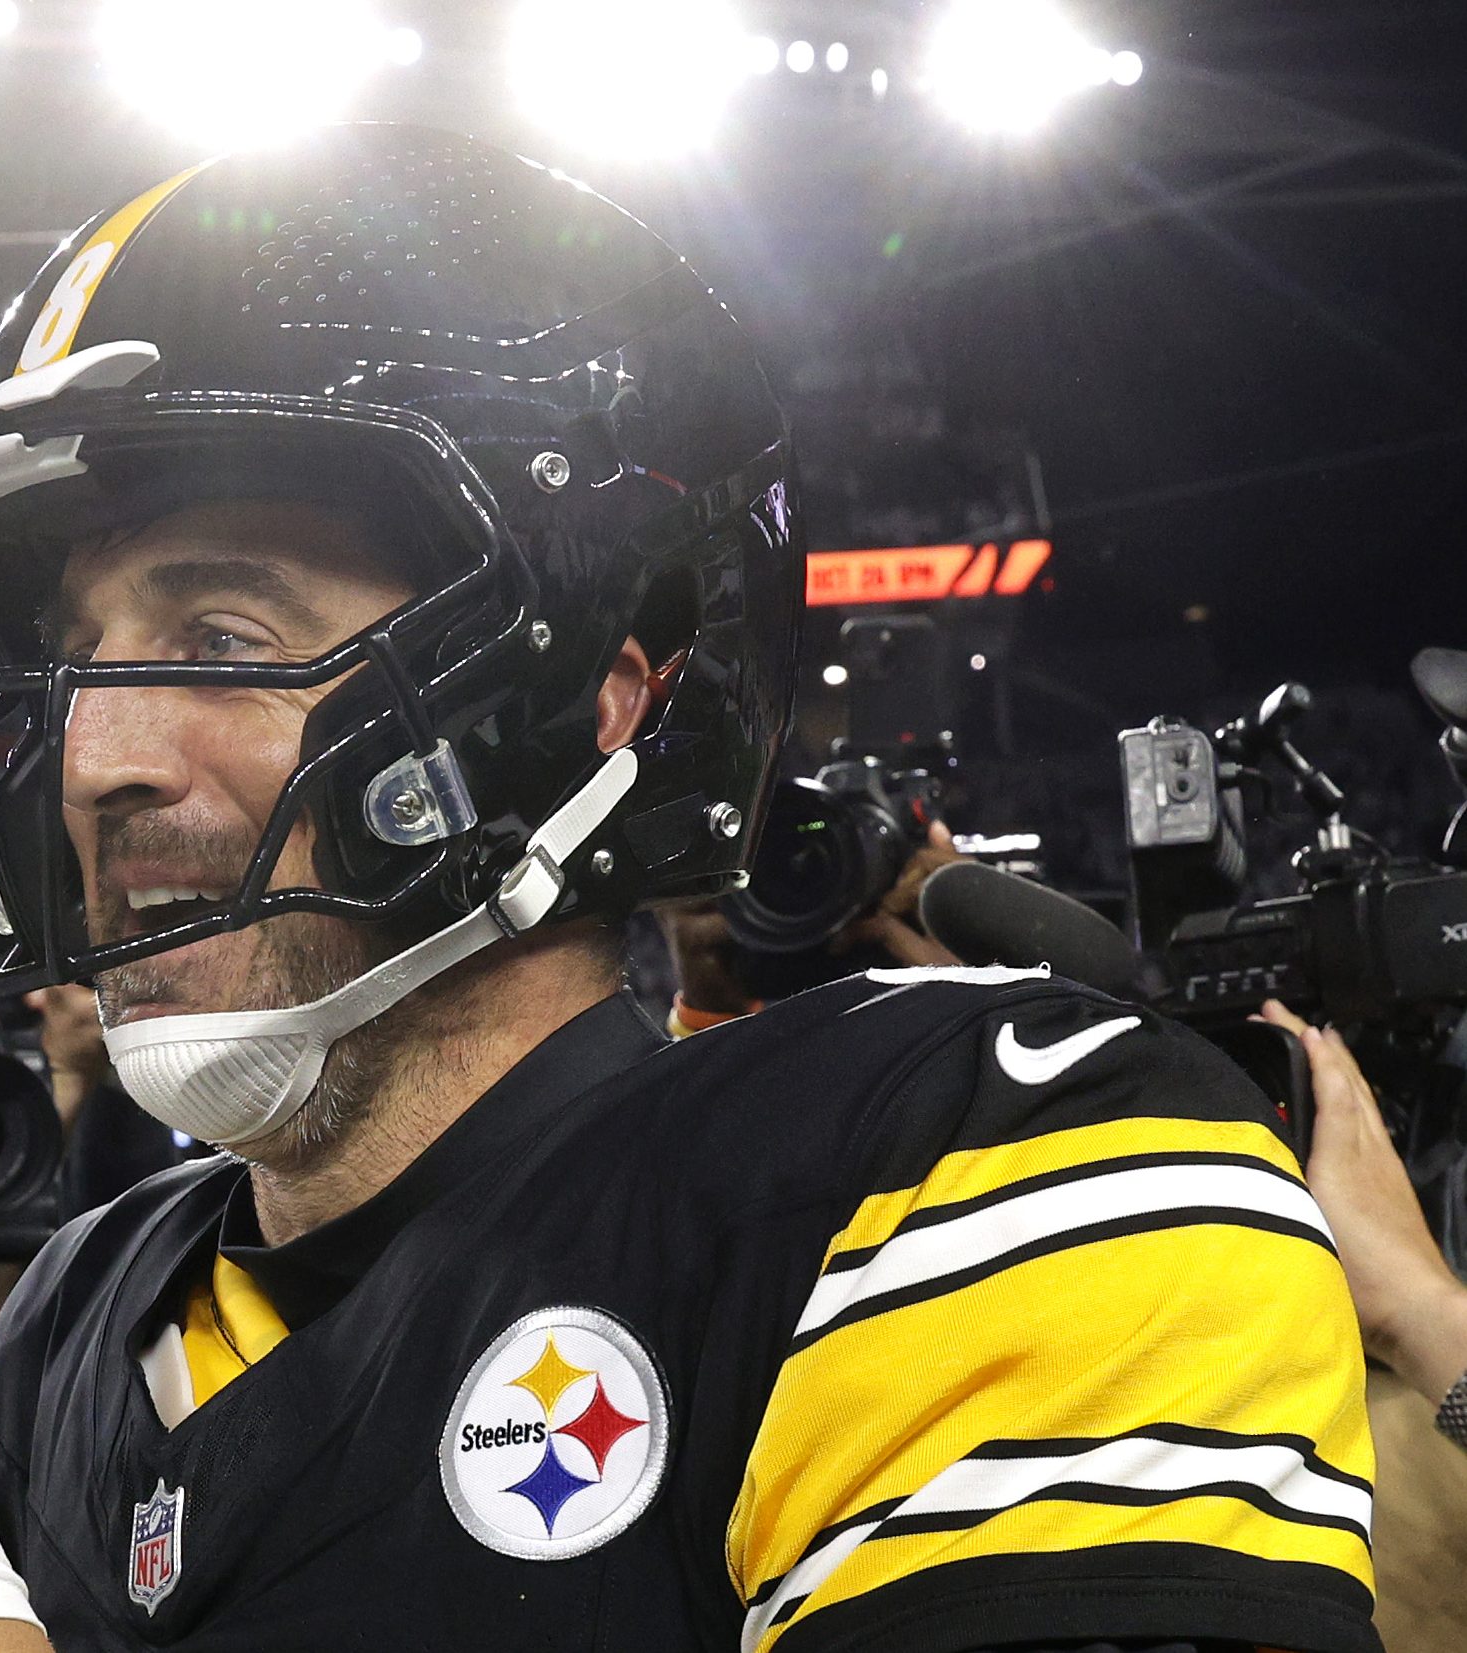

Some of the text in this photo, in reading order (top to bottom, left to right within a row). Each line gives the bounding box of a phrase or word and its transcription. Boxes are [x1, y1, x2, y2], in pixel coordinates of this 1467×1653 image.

[21, 241, 115, 372] 8
[461, 1418, 547, 1453] Steelers
[136, 1536, 170, 1589] NFL
